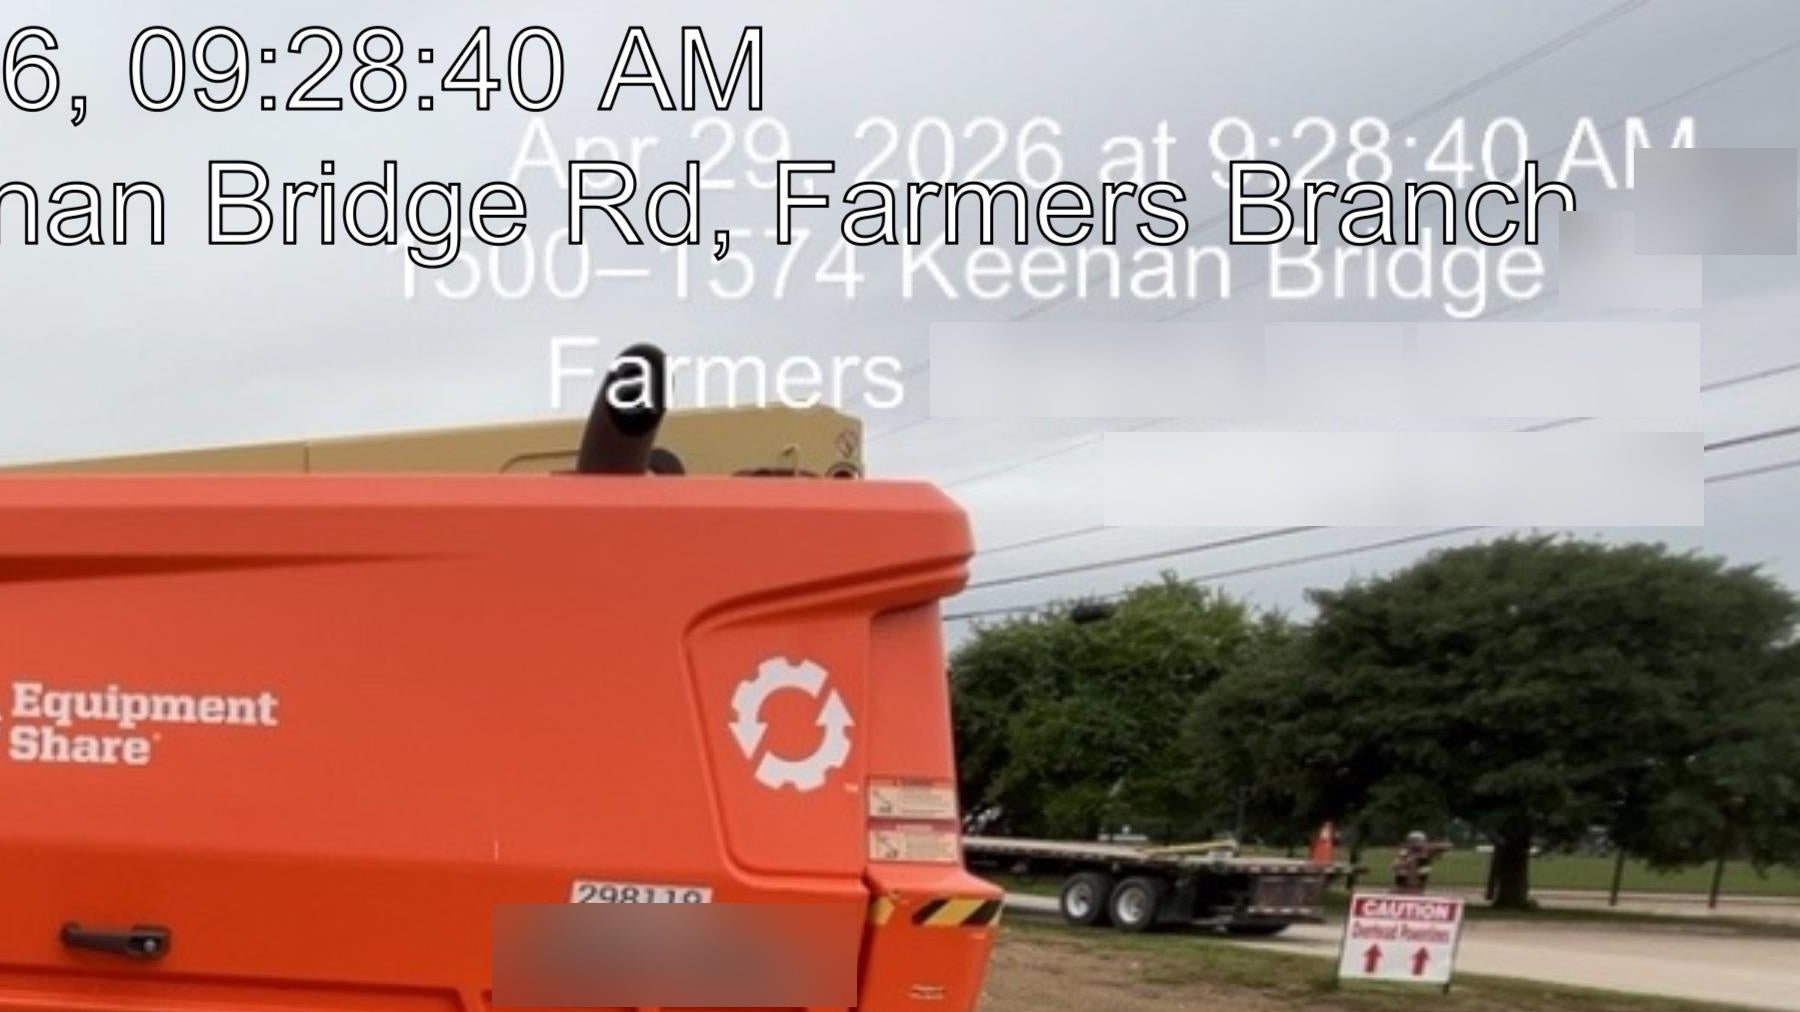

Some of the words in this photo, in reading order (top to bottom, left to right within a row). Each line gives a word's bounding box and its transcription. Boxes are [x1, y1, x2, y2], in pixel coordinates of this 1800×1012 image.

[11, 682, 278, 729] Equipment
[9, 725, 150, 765] Share
[1365, 900, 1448, 920] CAUTION
